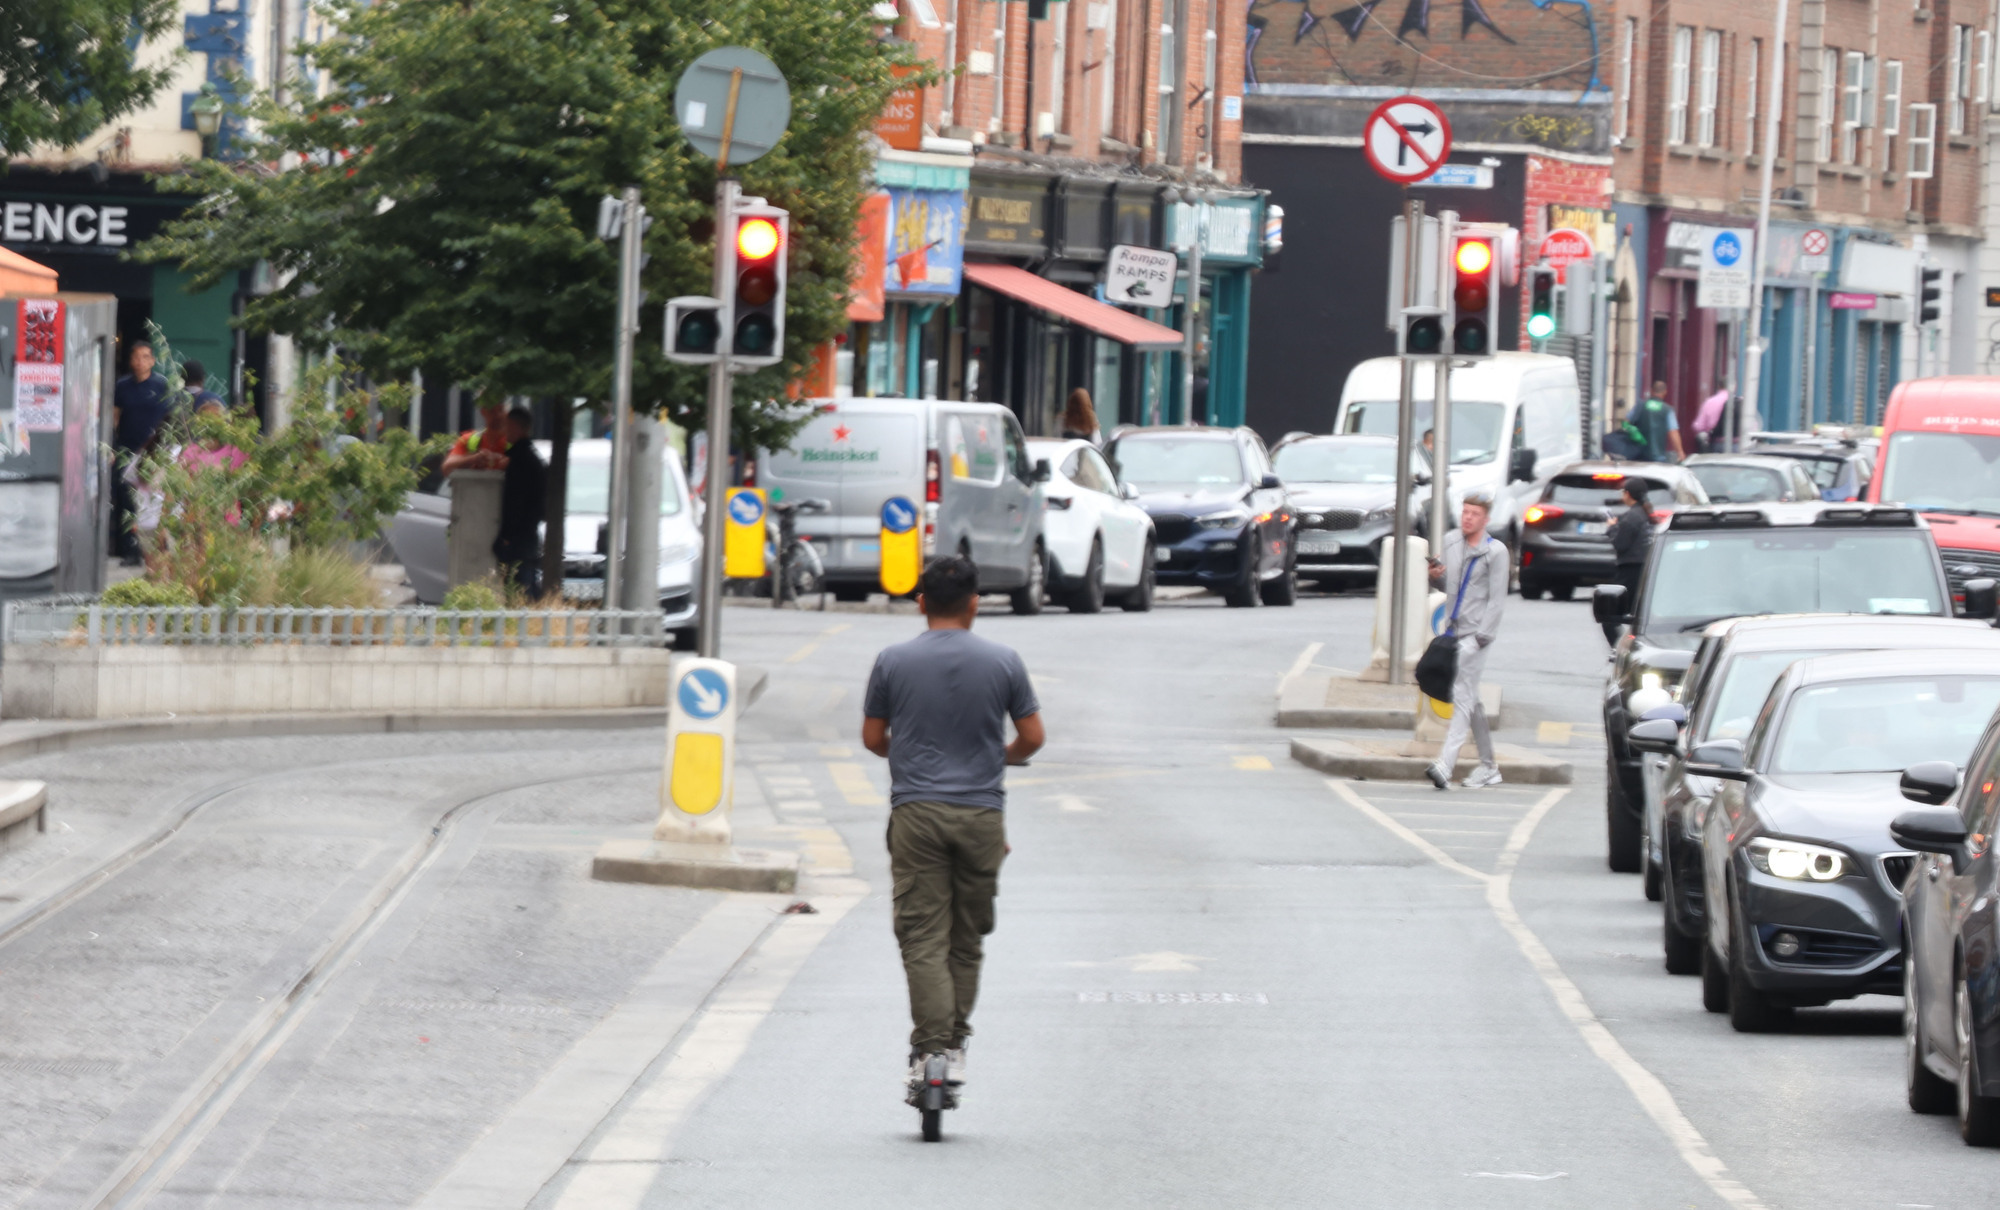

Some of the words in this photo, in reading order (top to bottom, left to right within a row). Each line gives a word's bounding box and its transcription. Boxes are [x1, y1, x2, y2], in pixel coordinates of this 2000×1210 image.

[0, 202, 128, 246] ENCE
[1116, 263, 1168, 282] RAMPS
[802, 447, 879, 462] Heineken
